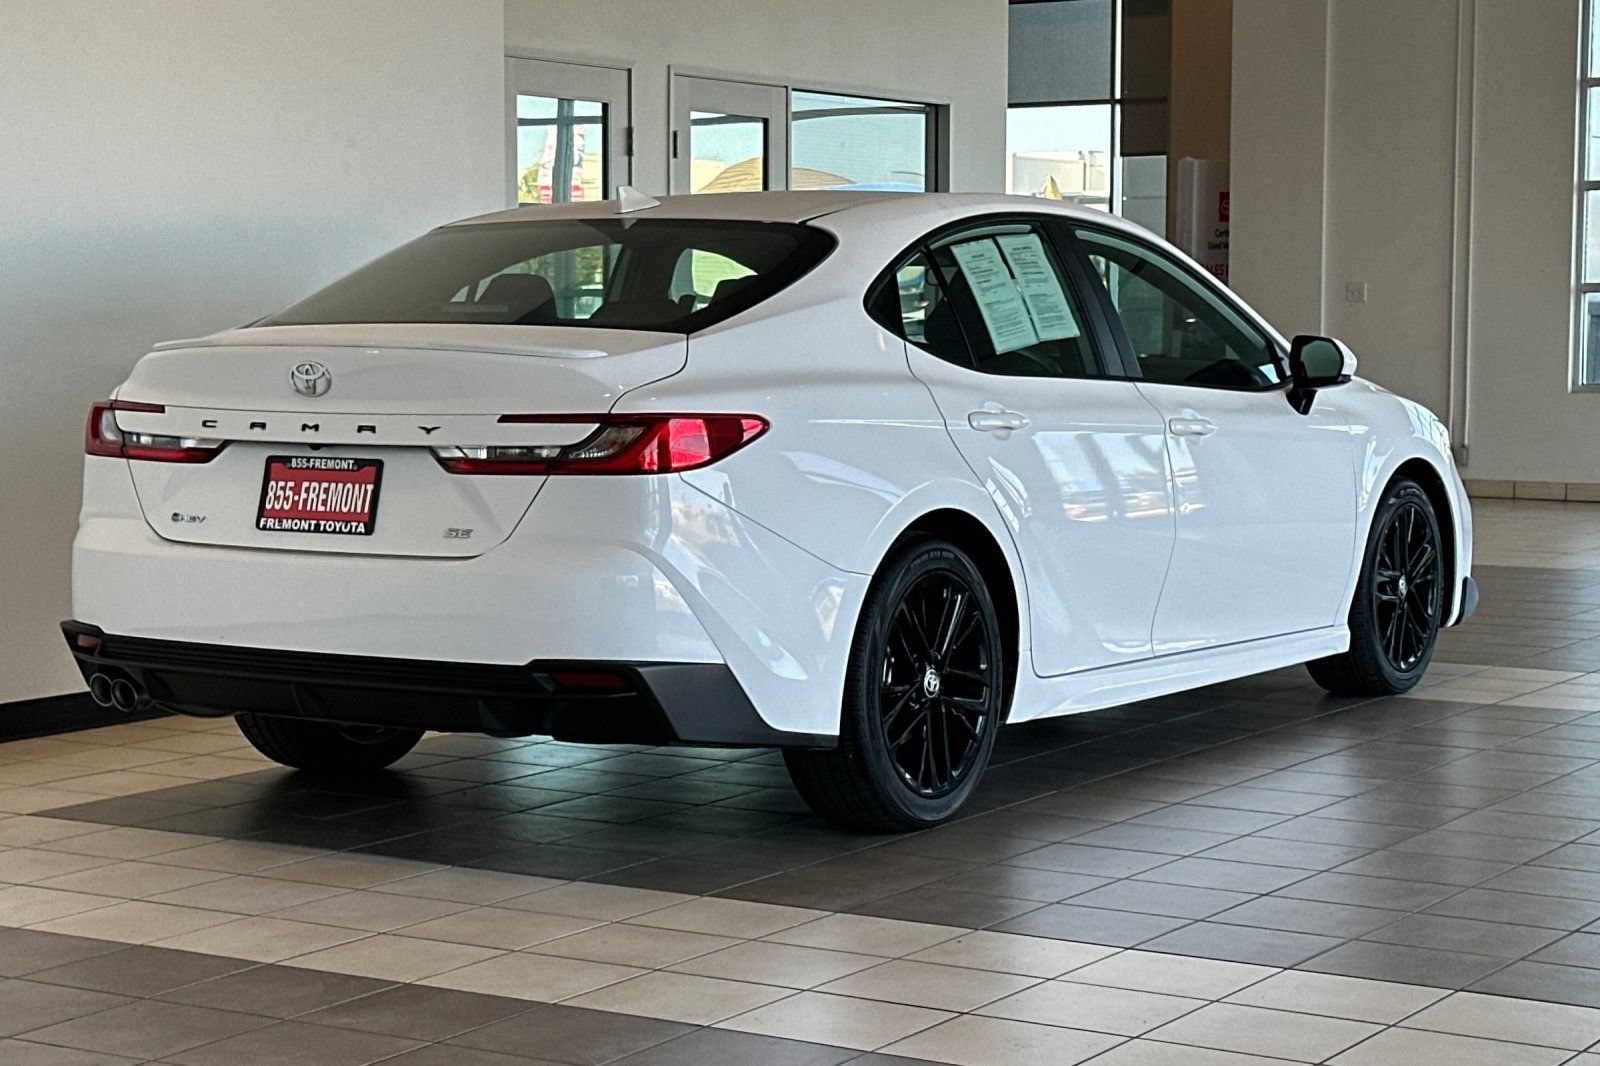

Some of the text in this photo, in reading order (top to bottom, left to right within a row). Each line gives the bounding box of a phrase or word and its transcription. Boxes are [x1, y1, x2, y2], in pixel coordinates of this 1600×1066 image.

[201, 419, 442, 435] CAMRY
[291, 457, 355, 470] 855-FREMONT
[265, 480, 375, 514] 855-FREMONT
